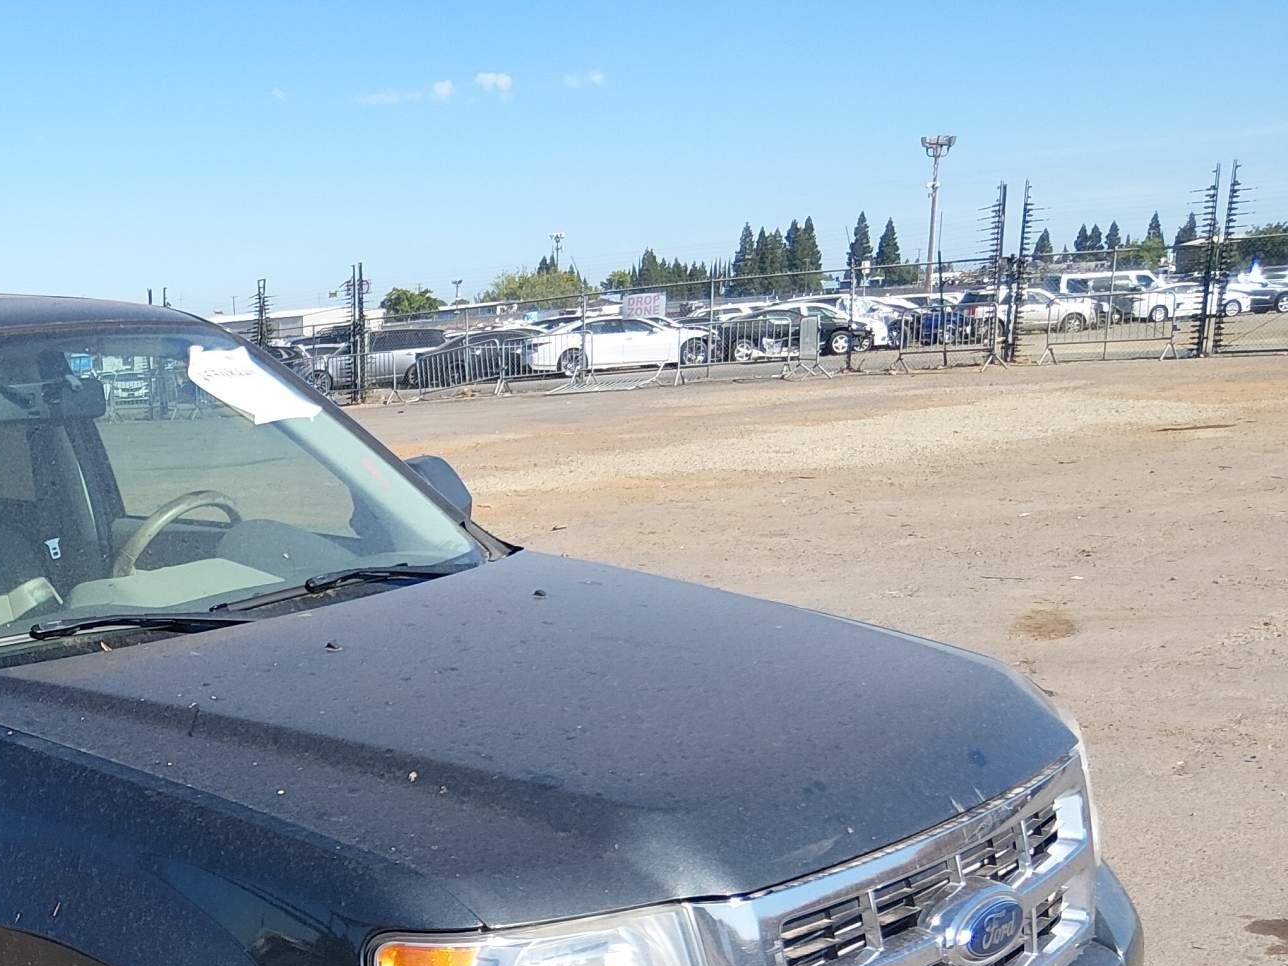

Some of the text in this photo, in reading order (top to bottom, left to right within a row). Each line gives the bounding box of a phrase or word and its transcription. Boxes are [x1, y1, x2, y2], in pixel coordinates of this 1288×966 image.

[627, 294, 660, 307] DROP
[626, 305, 660, 317] ZONE
[982, 908, 1015, 950] Ford
